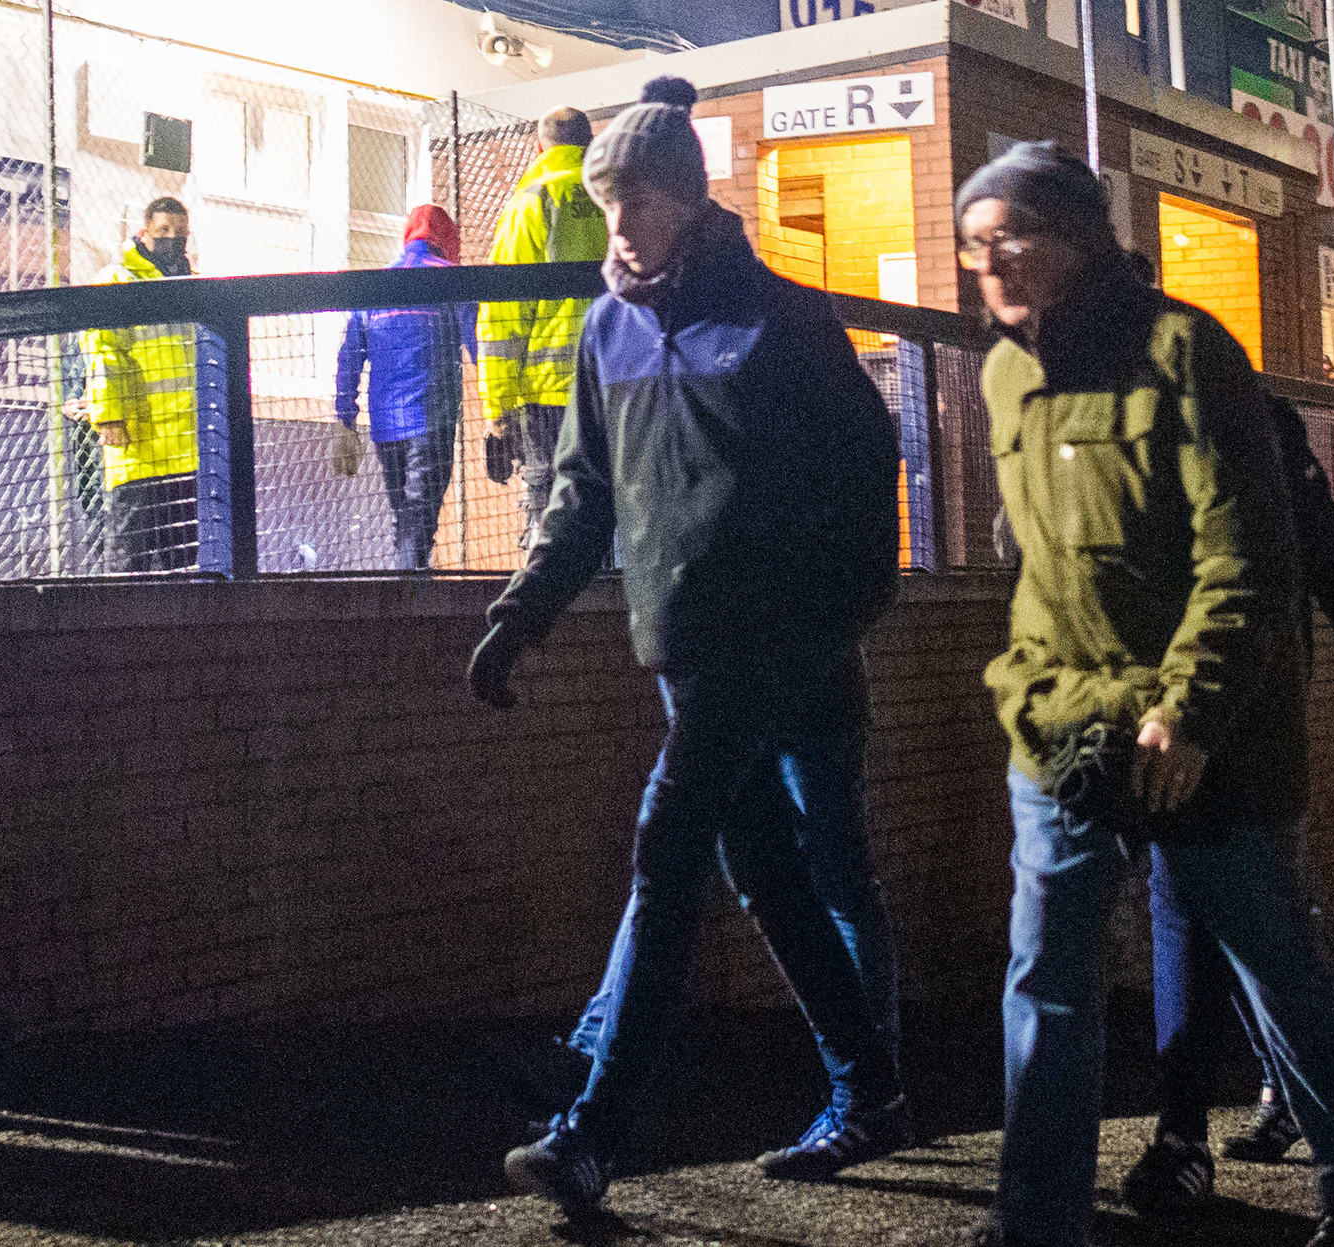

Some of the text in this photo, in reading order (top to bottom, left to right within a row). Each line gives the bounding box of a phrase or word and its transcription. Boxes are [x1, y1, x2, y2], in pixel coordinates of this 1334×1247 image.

[1266, 36, 1305, 84] TAXI
[770, 83, 876, 133] GATE R
[1173, 148, 1186, 185] S
[1238, 169, 1250, 204] T
